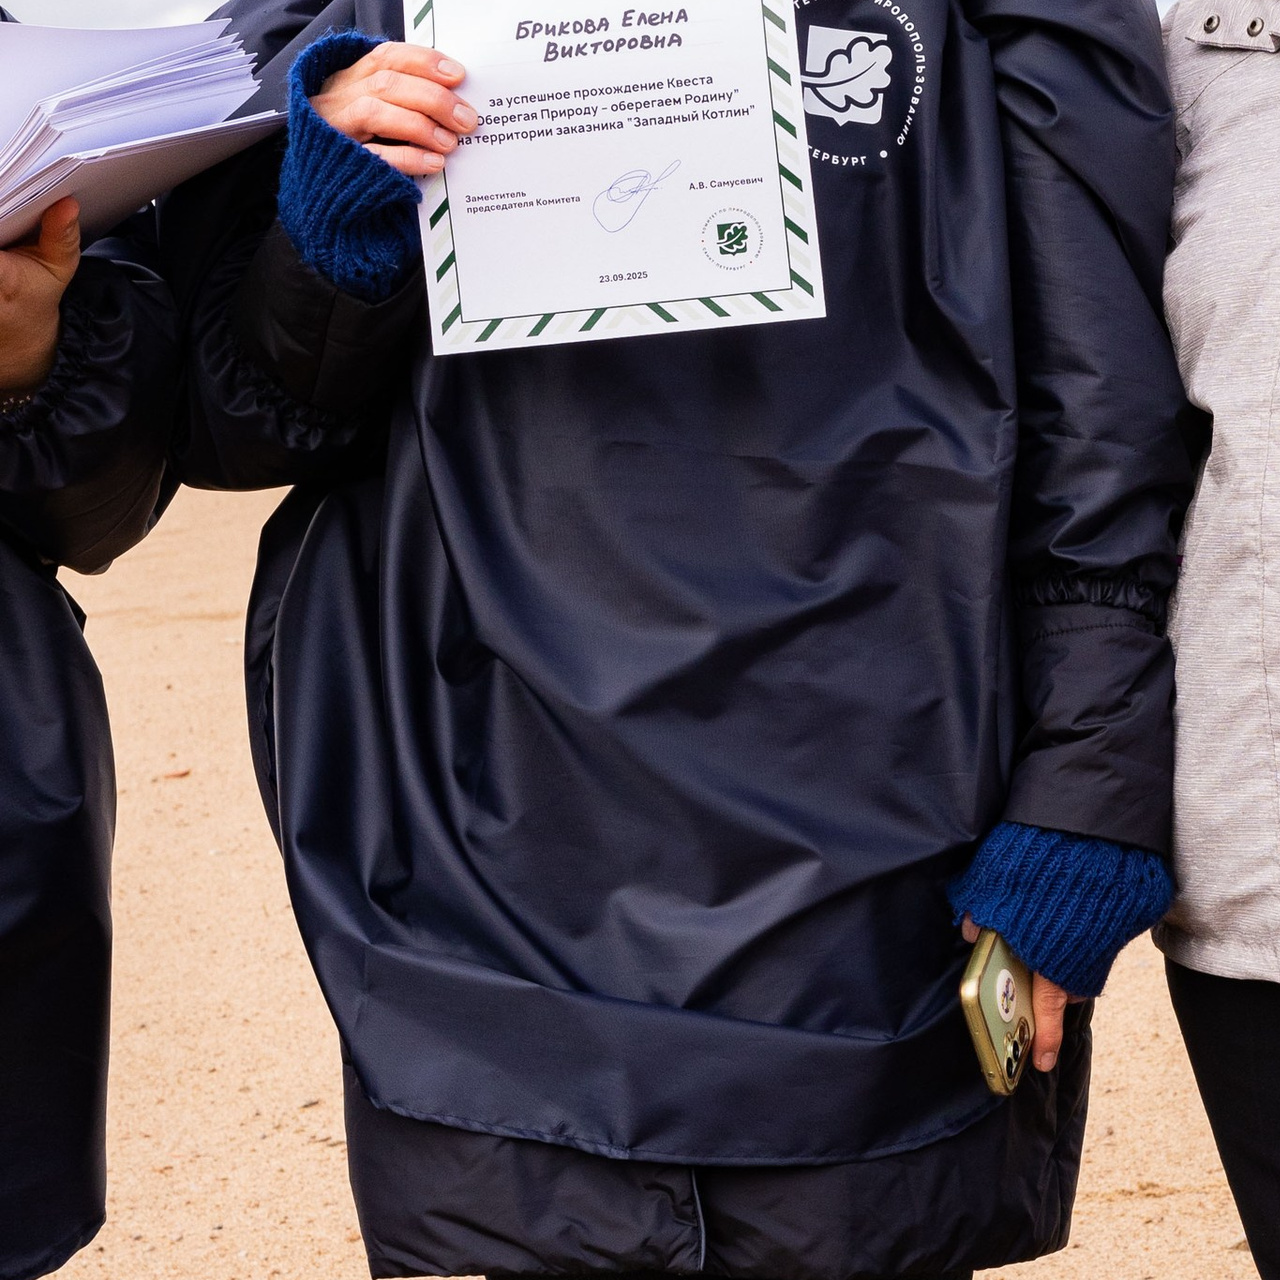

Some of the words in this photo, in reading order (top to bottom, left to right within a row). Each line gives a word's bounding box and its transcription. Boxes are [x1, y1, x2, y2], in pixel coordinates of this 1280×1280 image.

[489, 97, 504, 107] за
[506, 90, 571, 108] успешное
[573, 81, 664, 100] прохождение
[667, 76, 714, 89] Квеста
[540, 105, 599, 122] Природу
[610, 96, 682, 112] оберегаем
[457, 136, 472, 146] на
[474, 128, 553, 146] территории
[556, 120, 624, 136] заказника
[689, 181, 708, 191] А.В.
[709, 176, 763, 189] Самусевич
[465, 191, 527, 203] Заместитель
[466, 201, 534, 214] председателя
[536, 195, 581, 206] Комитета
[599, 271, 648, 283] 23.09.2025
